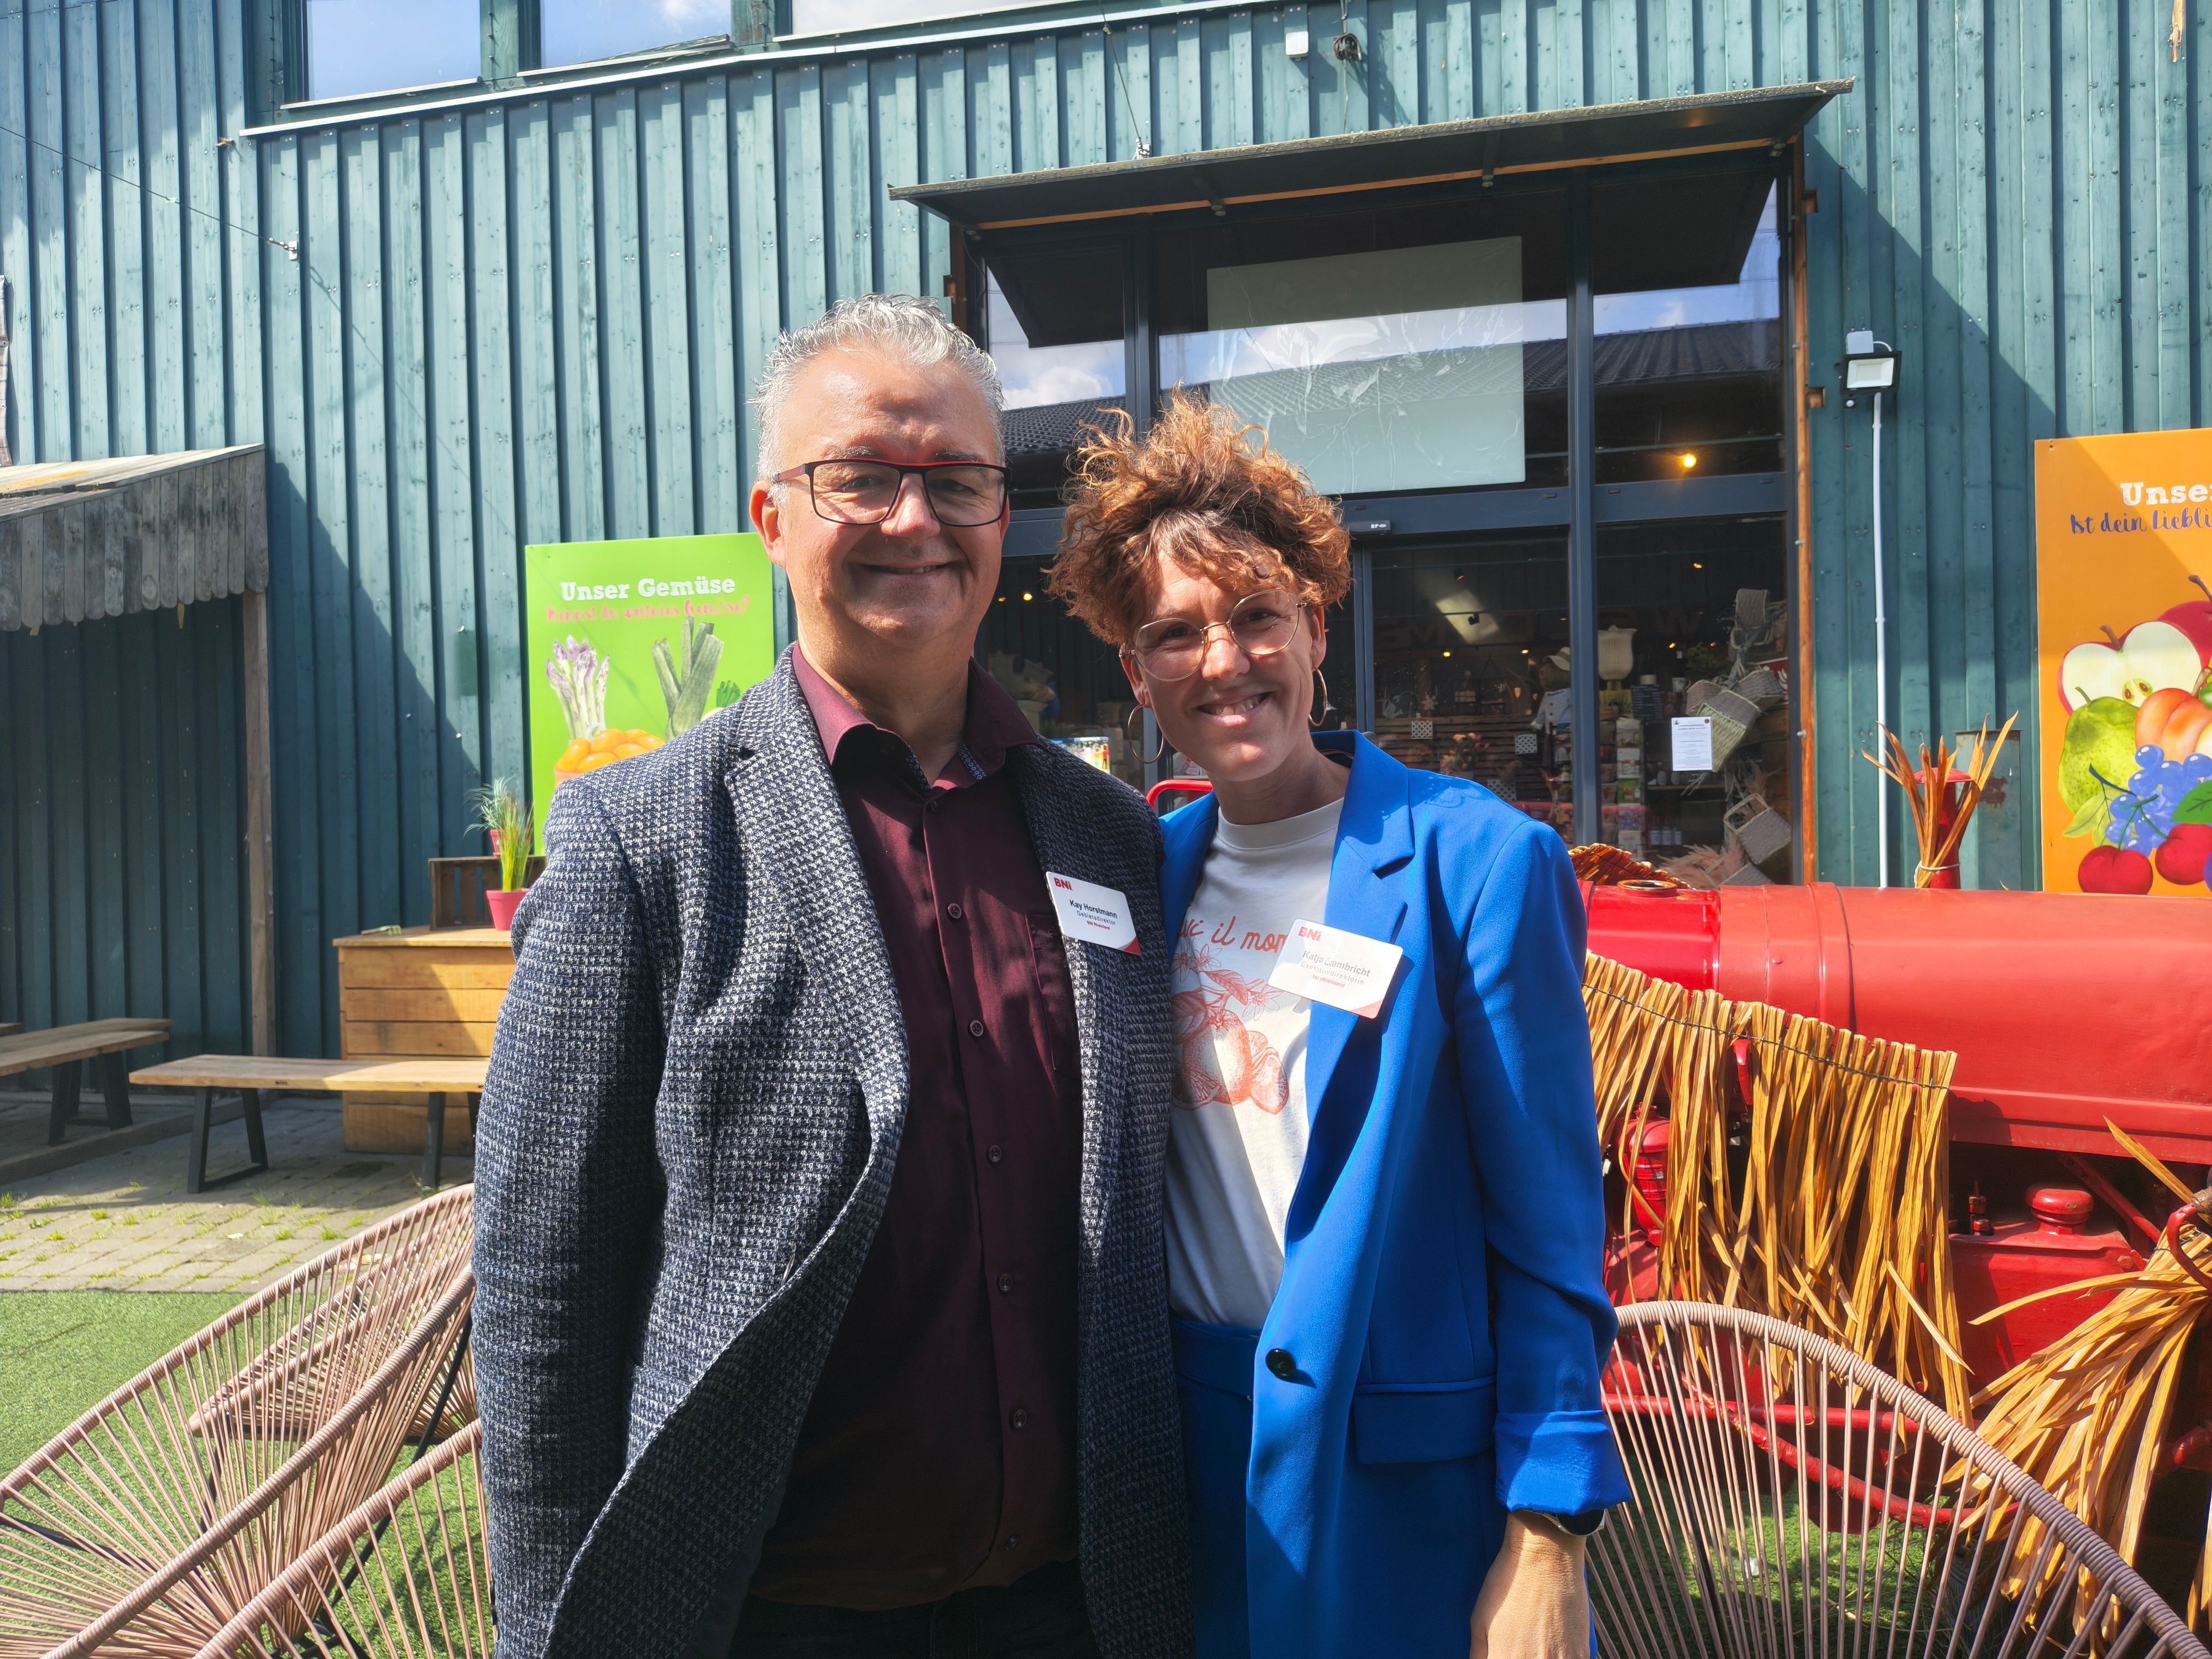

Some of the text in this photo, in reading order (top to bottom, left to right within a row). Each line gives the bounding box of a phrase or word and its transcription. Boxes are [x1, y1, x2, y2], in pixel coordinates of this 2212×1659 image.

[2120, 482, 2212, 506] Unse
[2070, 514, 2095, 534] Ist
[2100, 513, 2147, 533] dein
[560, 576, 735, 602] Unser Gemüse
[1070, 899, 1118, 919] Kay Horstmann
[1077, 910, 1116, 925] Gebietsdirektor
[1211, 916, 1235, 946] il
[1302, 950, 1371, 977] Katja Lambricht
